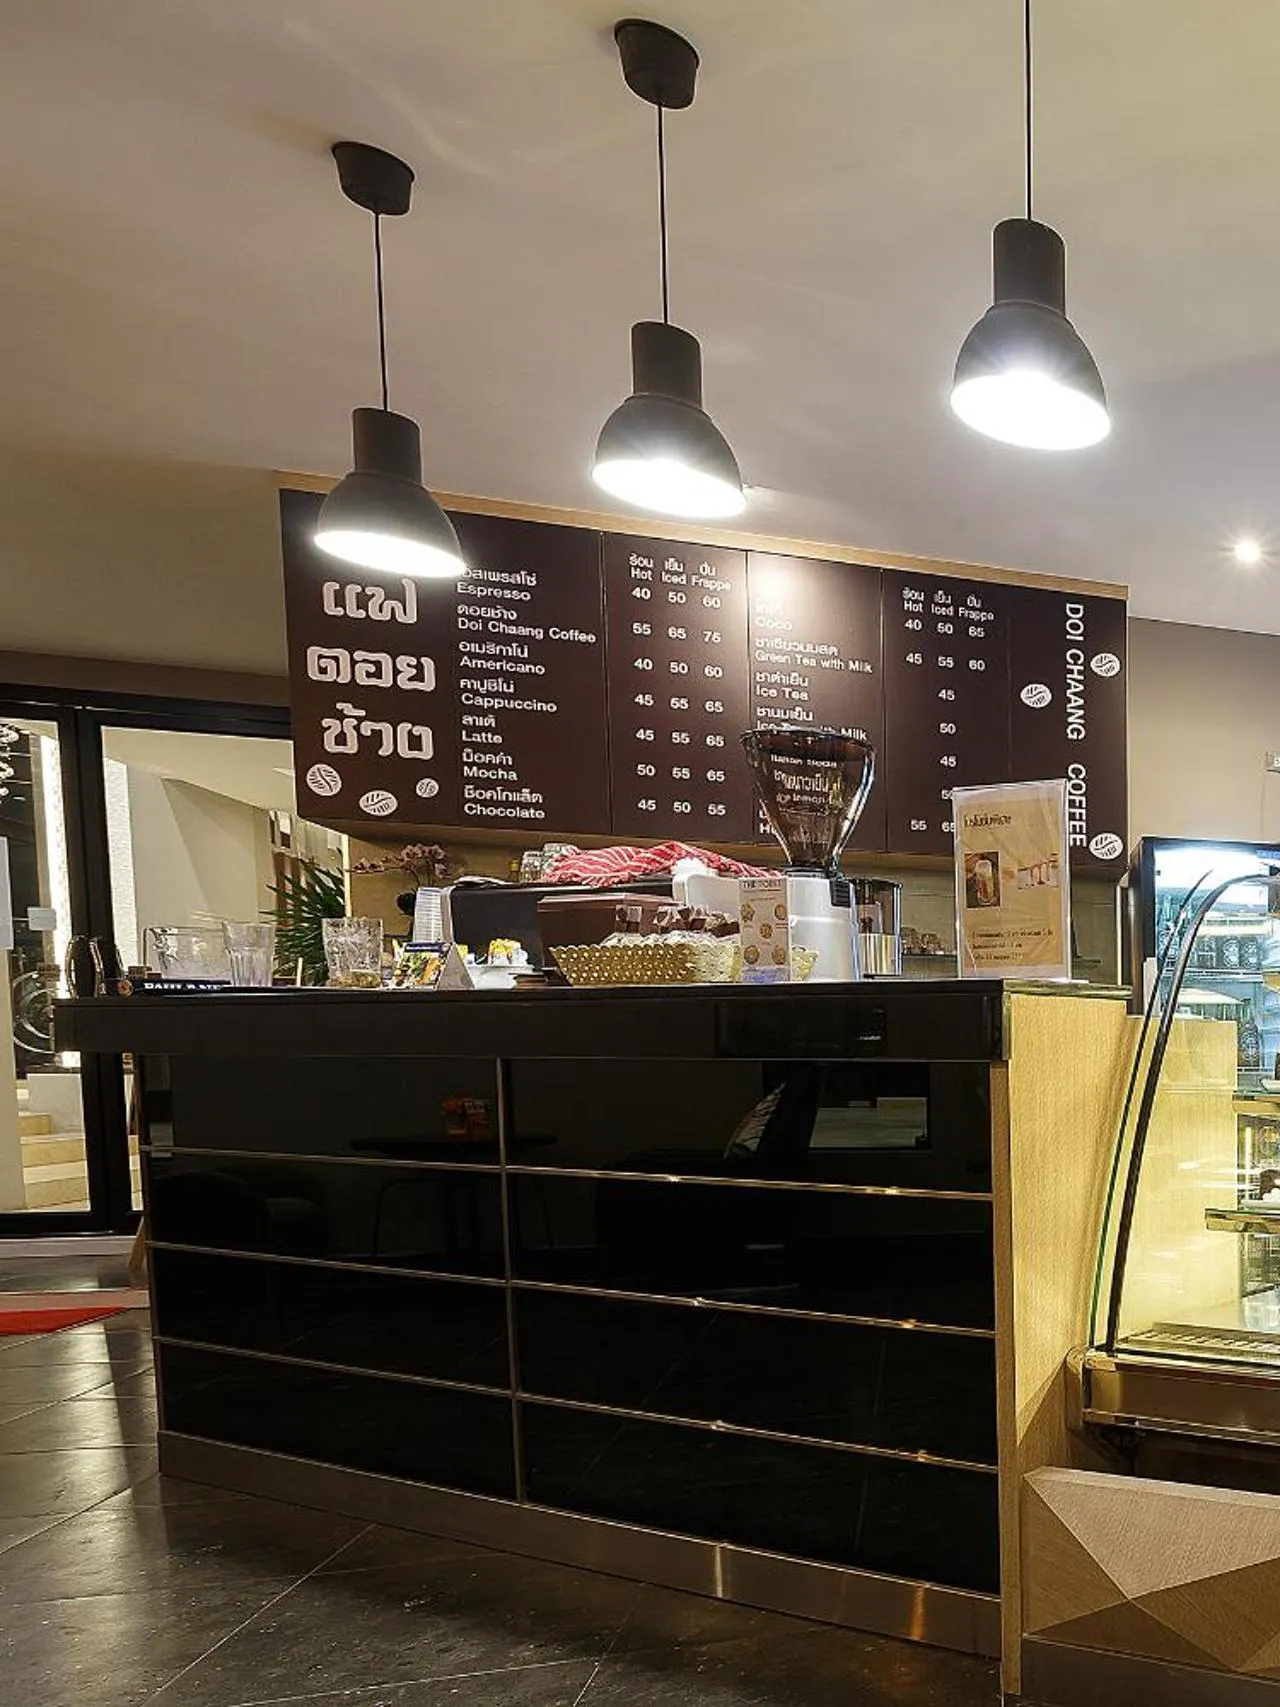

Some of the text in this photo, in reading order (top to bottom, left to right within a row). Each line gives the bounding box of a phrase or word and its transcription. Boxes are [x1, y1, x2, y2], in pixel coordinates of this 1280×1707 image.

[631, 567, 652, 581] Hot
[662, 571, 687, 584] Iced
[457, 582, 531, 601] Espresso
[632, 587, 720, 607] 40 50 60
[904, 600, 923, 612] Hot
[931, 604, 953, 616] Iced
[458, 617, 597, 643] Doi Chaang Coffee
[633, 623, 721, 643] 55 65 75
[904, 619, 985, 638] 40 50 65
[306, 646, 437, 692] ดอย
[460, 655, 545, 675] Americano
[634, 659, 723, 678] 40 50 60
[756, 651, 873, 674] Green Tea with Milk
[906, 653, 985, 671] 45 55 60
[756, 684, 809, 701] Ice Tea
[938, 689, 955, 701] 45
[461, 693, 557, 712] Cappuccino
[634, 694, 724, 713] 45 55 65
[321, 702, 434, 761] ช้าง
[939, 723, 956, 734] 50
[1065, 603, 1087, 848] DOI CHAANG COFFEE
[462, 730, 503, 743] Latte
[636, 729, 725, 747] 45 55 65
[940, 756, 956, 767] 45
[463, 766, 518, 780] Mocha
[637, 764, 725, 781] 50 55 65
[464, 803, 545, 819] Chocolate
[638, 799, 656, 811] 45
[673, 802, 691, 813] 50
[910, 820, 927, 831] 55
